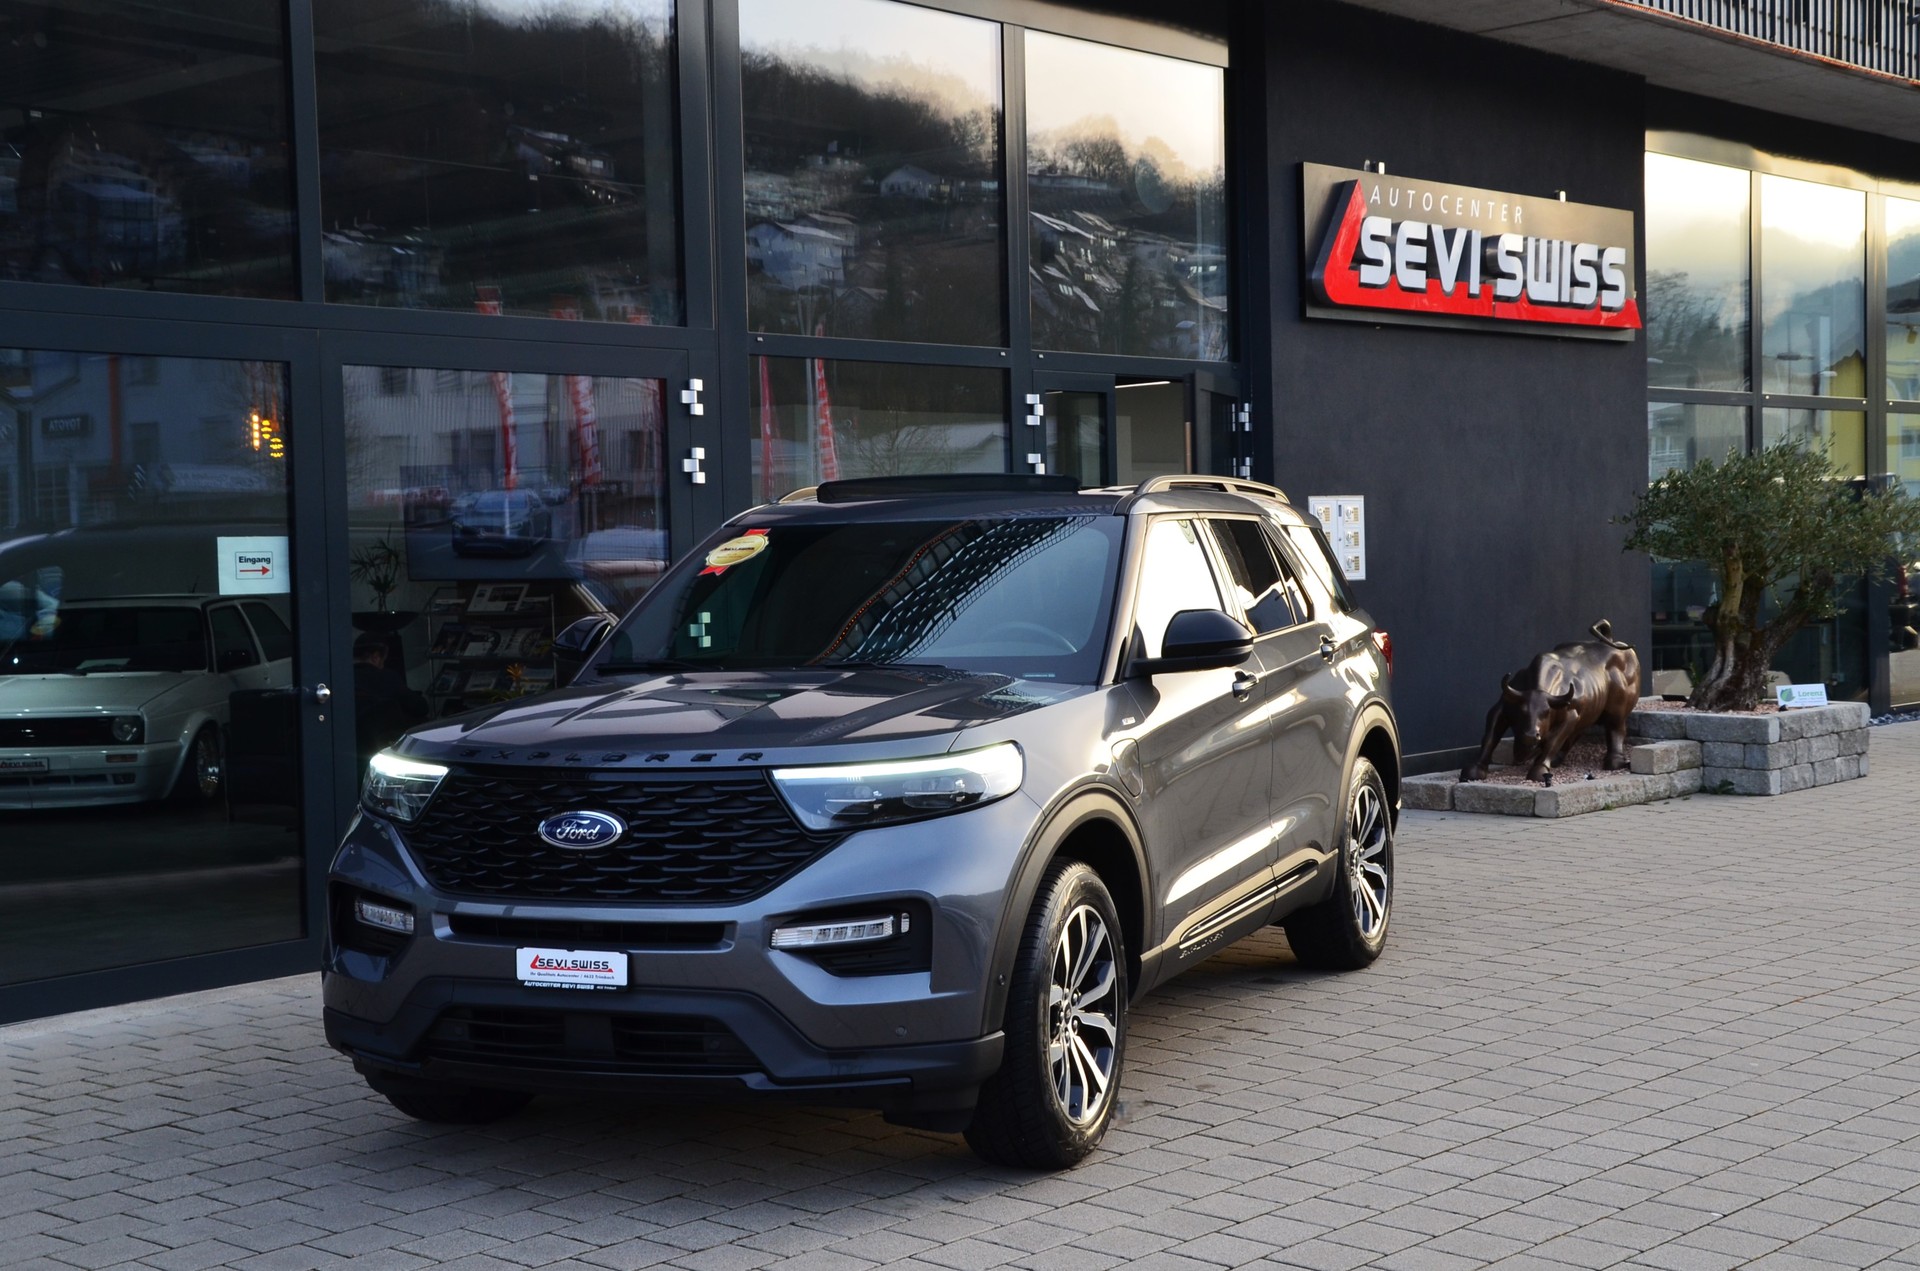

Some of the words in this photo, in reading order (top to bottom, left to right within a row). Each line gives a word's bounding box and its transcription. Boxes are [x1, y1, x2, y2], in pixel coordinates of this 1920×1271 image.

[1369, 184, 1523, 224] AUTOCENTER
[1358, 215, 1482, 297] SEVI
[1494, 232, 1627, 309] SWISS
[238, 556, 271, 565] Eingang
[460, 749, 764, 763] EXPLORER
[556, 818, 601, 840] Ford
[538, 958, 568, 968] SEVI
[571, 960, 609, 970] SWISS
